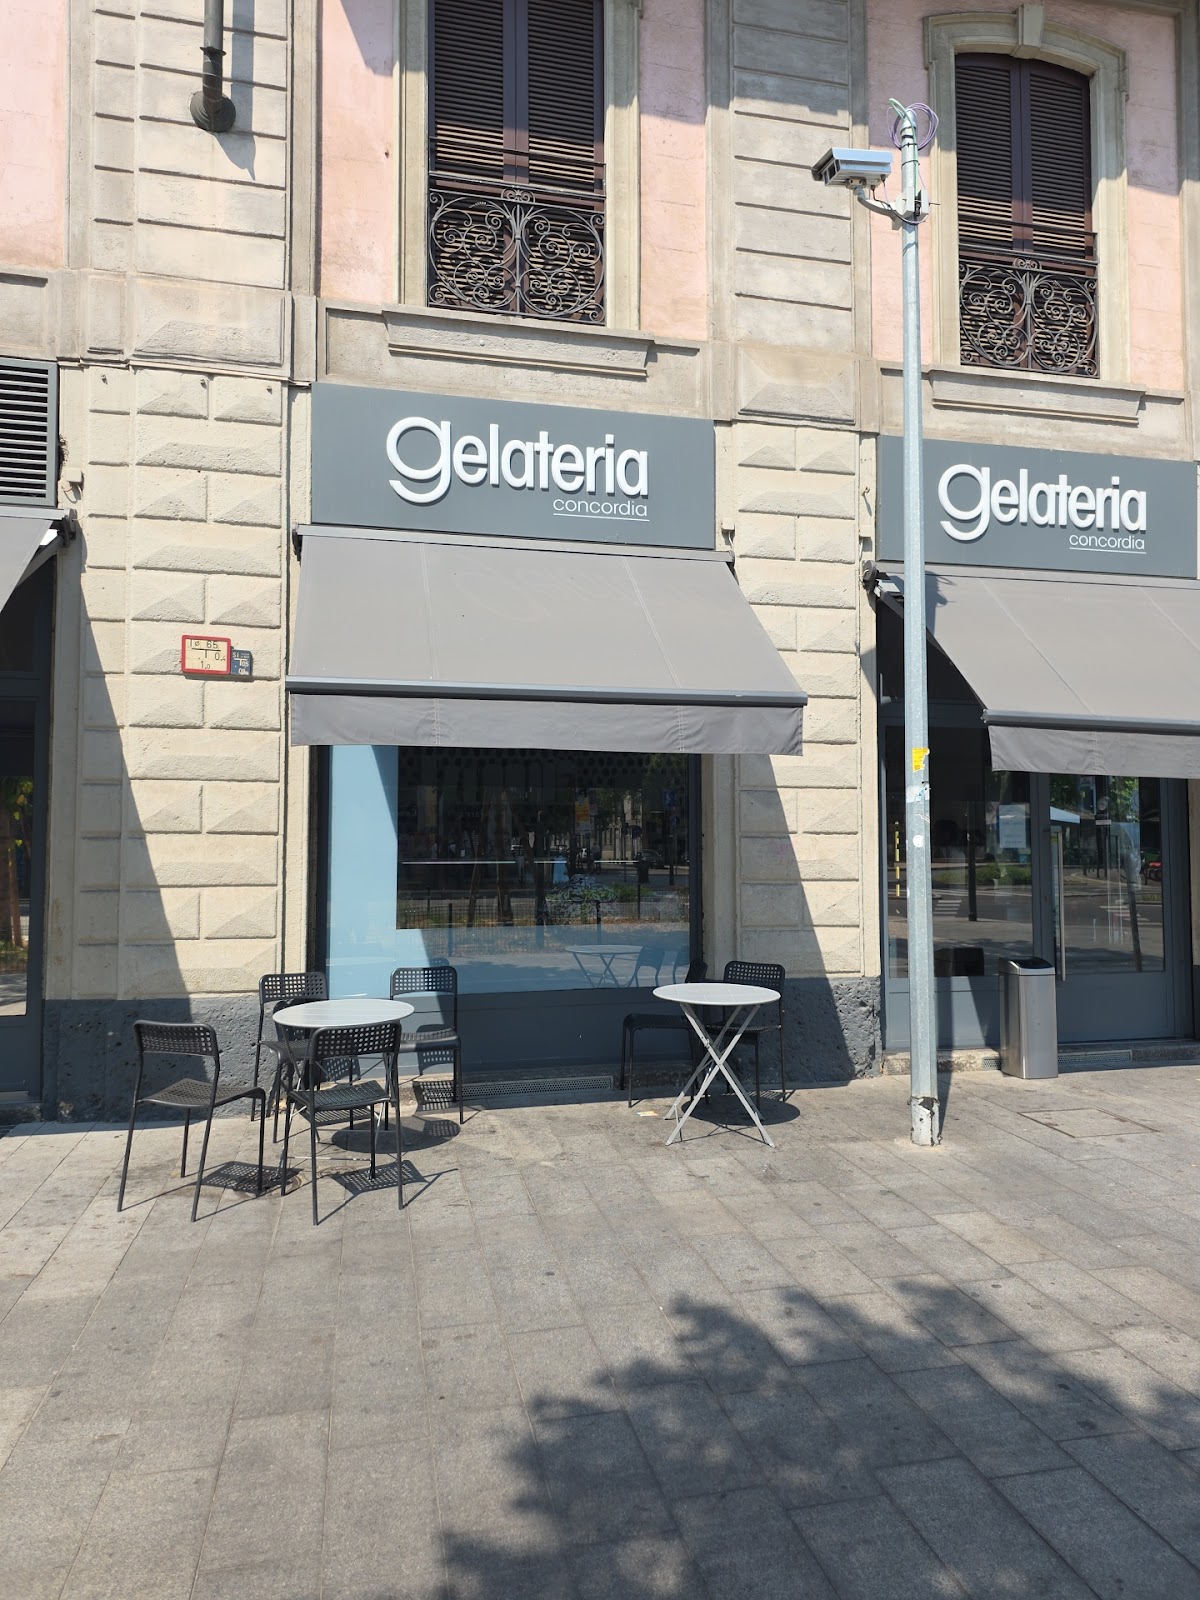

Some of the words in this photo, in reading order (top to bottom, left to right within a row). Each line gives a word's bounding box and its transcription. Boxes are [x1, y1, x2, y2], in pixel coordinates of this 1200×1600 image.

[386, 416, 649, 504] gelateria
[552, 498, 648, 517] concordia
[937, 463, 1147, 541] gelateria
[1069, 533, 1145, 550] concordia
[206, 640, 218, 649] 65
